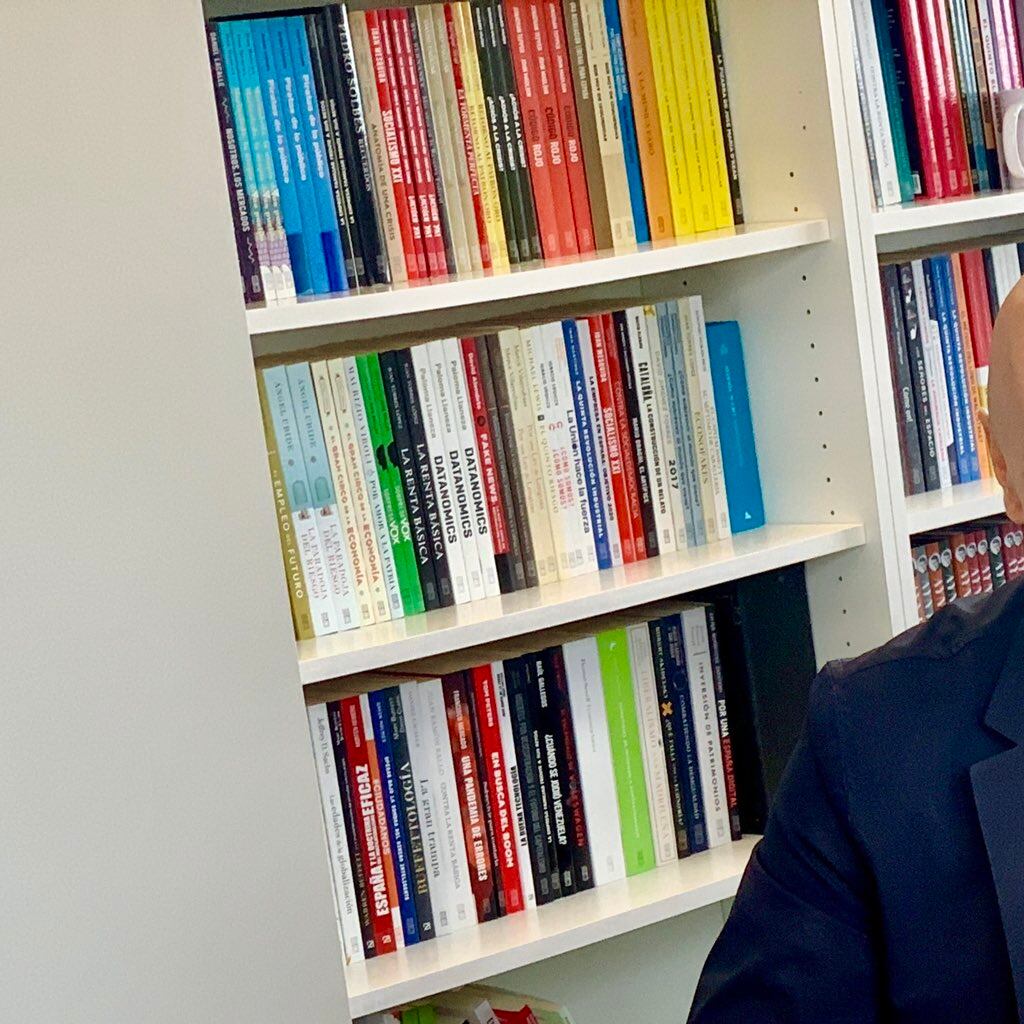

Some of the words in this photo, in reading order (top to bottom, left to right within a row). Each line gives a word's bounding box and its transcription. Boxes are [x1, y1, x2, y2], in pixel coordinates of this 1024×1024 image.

[300, 73, 315, 112] Piratas
[307, 114, 317, 127] de
[309, 129, 319, 140] lo
[368, 122, 385, 169] ANATOMÍA
[380, 109, 401, 165] SOCIALISMO
[566, 138, 578, 163] ROJO
[311, 140, 326, 179] público
[390, 165, 403, 184] XXI
[377, 170, 387, 186] DE
[380, 188, 391, 209] UNA
[384, 211, 397, 241] CRISIS
[574, 380, 582, 393] LA
[900, 386, 911, 405] Come
[565, 409, 575, 423] La
[576, 395, 587, 427] QUINTA
[645, 403, 652, 412] LA
[449, 359, 462, 394] Paloma
[464, 447, 486, 535] DATANOMICS
[567, 424, 580, 457] Unión
[646, 413, 660, 466] CONSTRUCCIÓN
[398, 447, 411, 466] LA
[572, 458, 584, 485] hace
[582, 428, 597, 485] REVOLUCIÓN
[654, 467, 661, 477] DE
[655, 478, 662, 487] UN
[667, 459, 679, 490] 2017
[402, 468, 419, 512] RENTA
[433, 455, 456, 544] DATANOMICS
[449, 449, 472, 538] DATANOMICS
[577, 486, 586, 497] la
[656, 488, 666, 514] RELATO
[579, 498, 592, 534] fuerza
[590, 487, 604, 539] INDUSTRIAL
[412, 515, 431, 565] BÁSICA
[535, 660, 544, 676] RAÚL
[480, 680, 489, 696] TOM
[536, 677, 548, 708] GALLEGOS
[696, 661, 711, 720] INVERSIÓN
[483, 697, 494, 727] PETERS
[716, 699, 727, 718] POR
[704, 723, 712, 737] DE
[718, 718, 729, 738] UNA
[459, 754, 473, 776] UNA
[490, 751, 499, 768] EN
[542, 733, 556, 768] ¿CUÁNDO
[721, 738, 736, 772] ESPAÑA
[418, 777, 431, 796] La
[548, 768, 557, 778] SE
[705, 739, 722, 812] PATRIMONIOS
[355, 763, 374, 815] EFICAZ
[462, 776, 480, 826] PANDEMIA
[492, 770, 505, 807] BUSCA
[726, 773, 738, 808] DIGITAL
[420, 797, 433, 825] gran
[497, 808, 508, 831] DEL
[552, 799, 567, 846] VENEZUELA?
[470, 825, 482, 839] DE
[426, 826, 441, 878] trampa
[472, 840, 487, 882] ERRORES
[501, 832, 514, 868] BOOM
[368, 863, 389, 917] ESPAÑA
